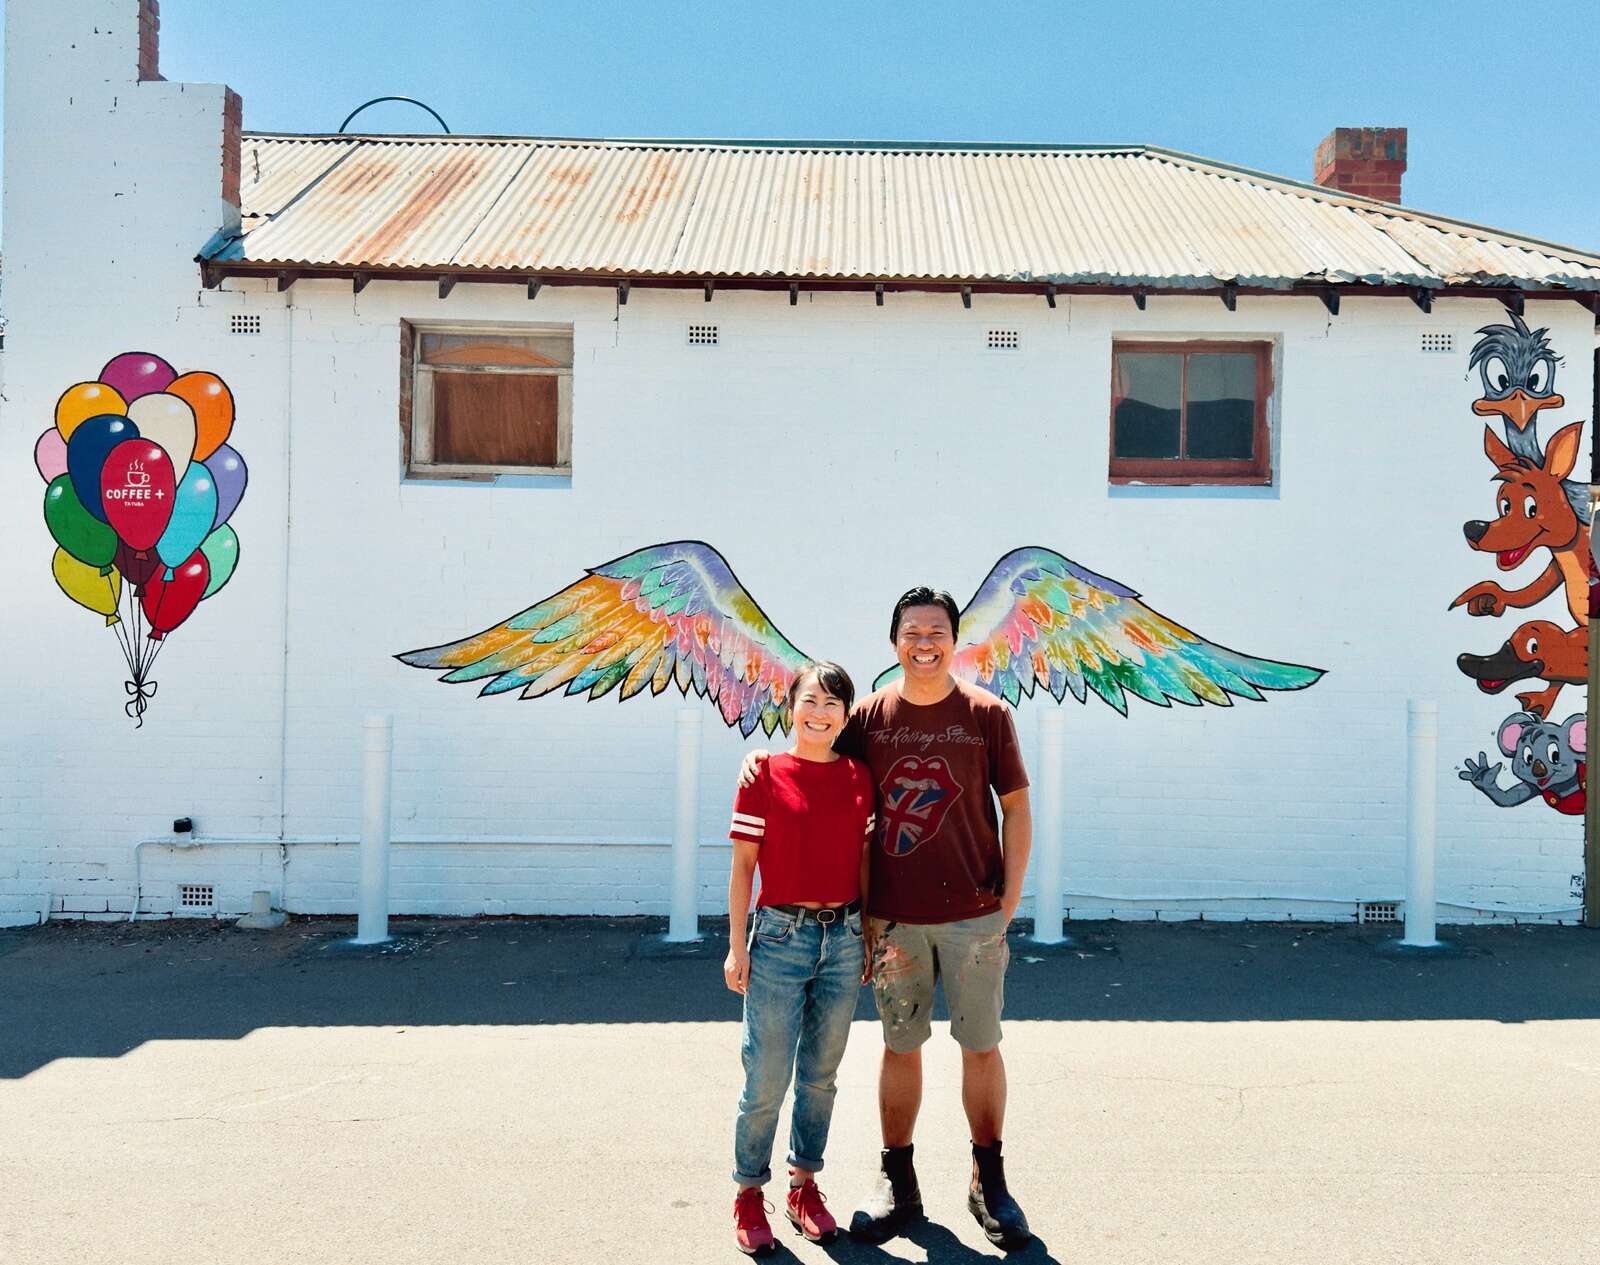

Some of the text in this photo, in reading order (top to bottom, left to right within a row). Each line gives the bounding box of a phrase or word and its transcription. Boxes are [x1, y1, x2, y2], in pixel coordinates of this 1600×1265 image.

[106, 489, 151, 499] COFFEE
[868, 724, 984, 752] The Rolling Stones
